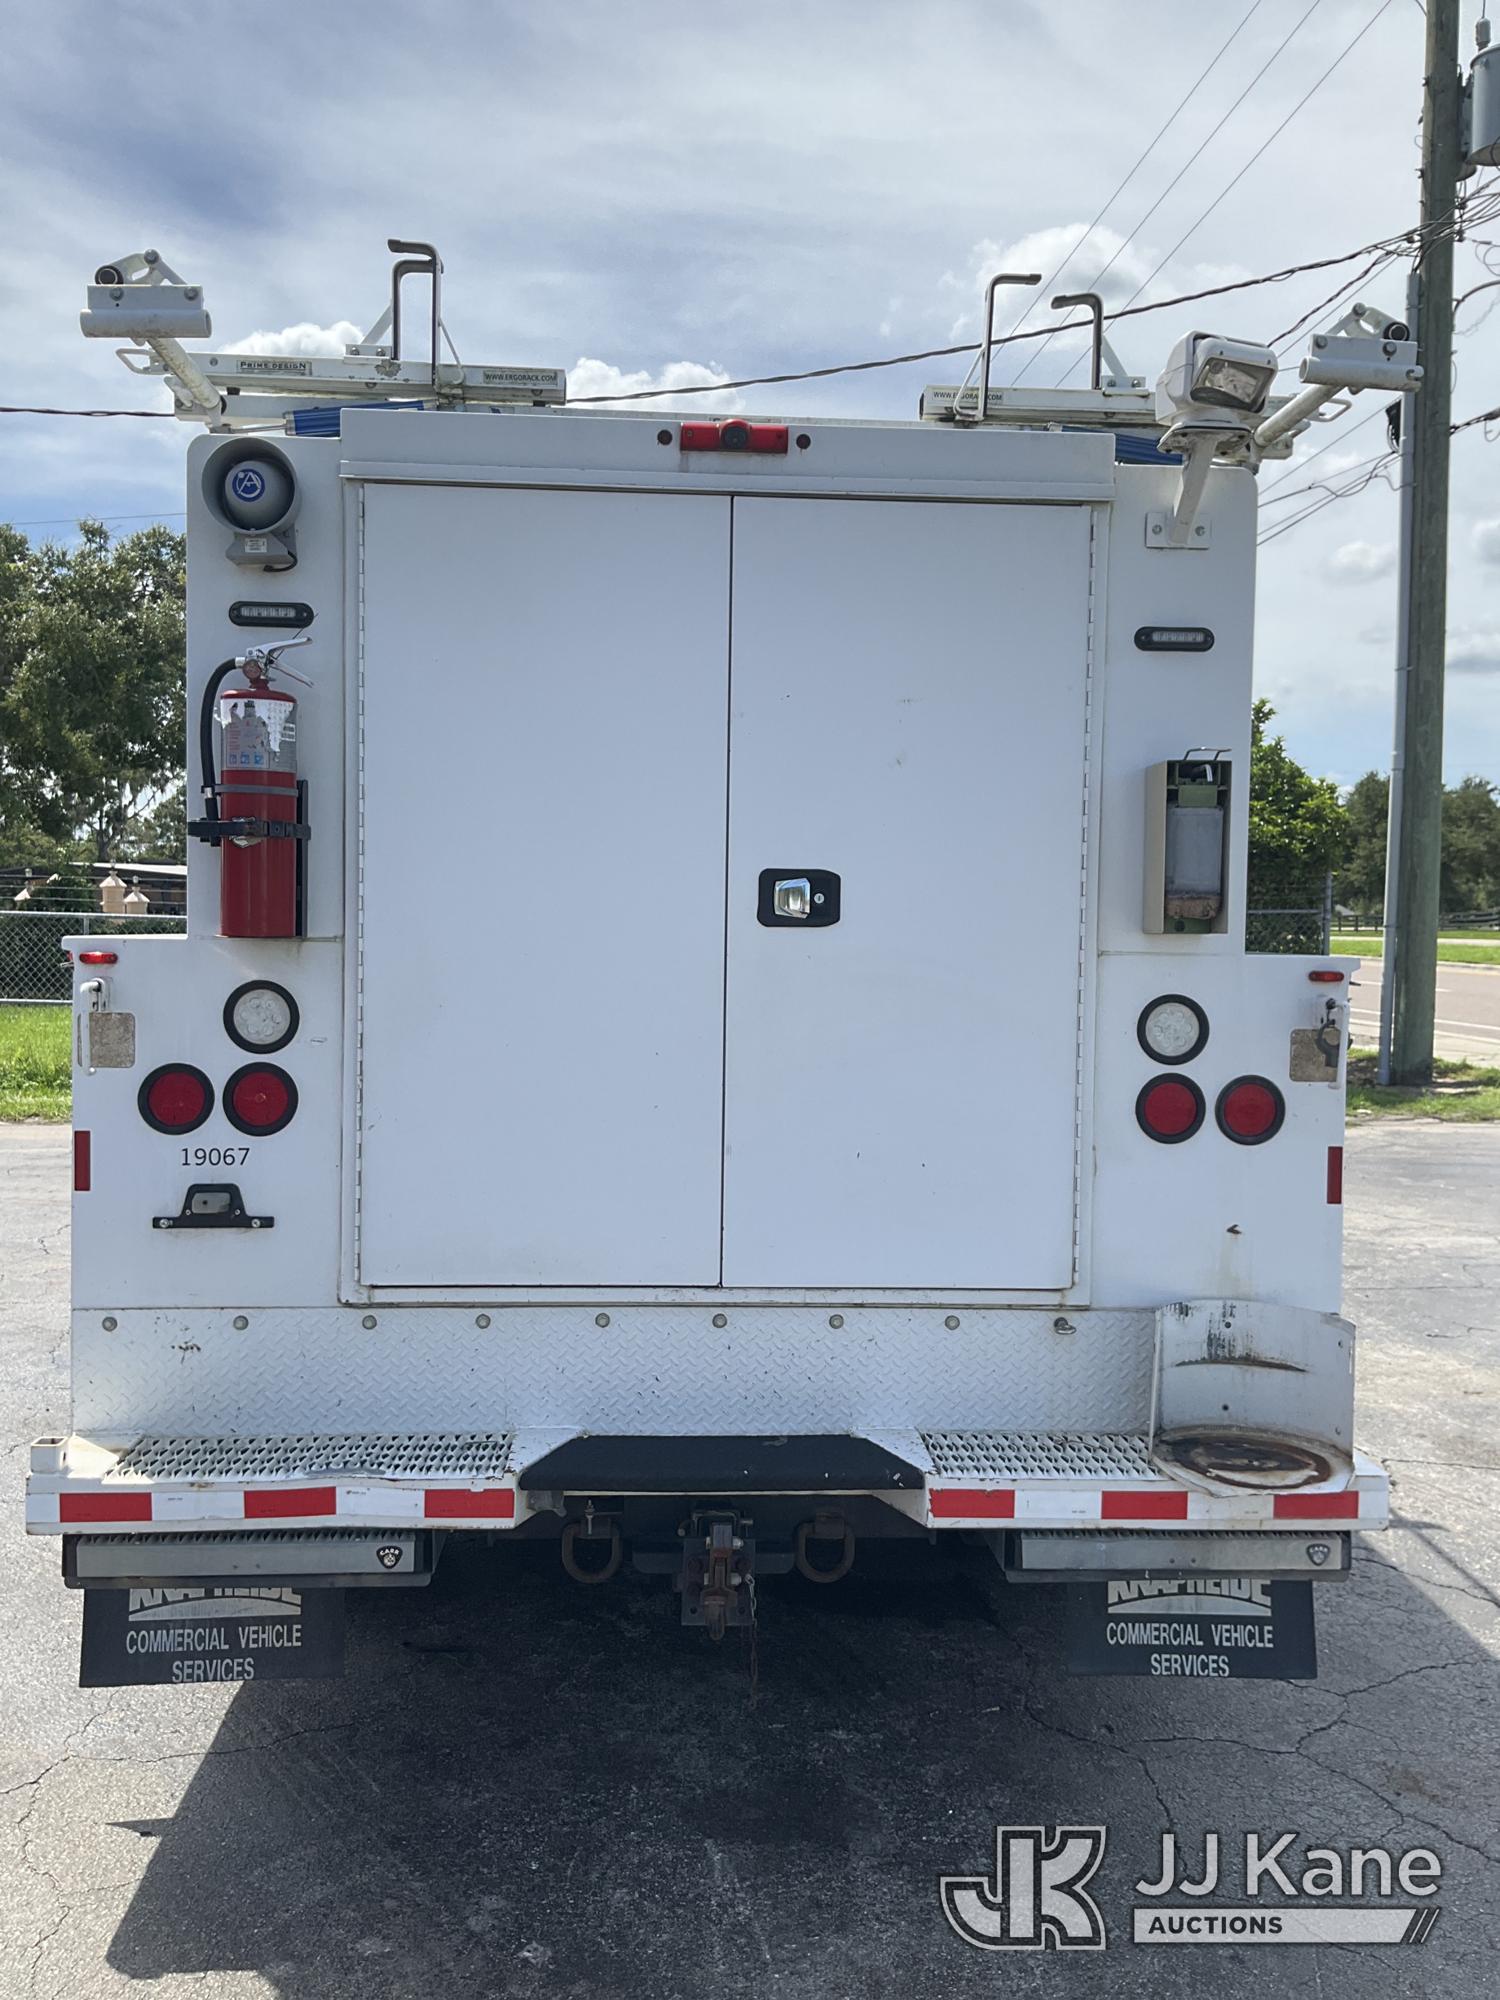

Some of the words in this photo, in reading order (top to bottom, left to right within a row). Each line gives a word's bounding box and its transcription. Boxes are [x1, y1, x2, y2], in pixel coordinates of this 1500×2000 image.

[240, 361, 268, 369] PRIME
[271, 362, 306, 370] DESIGN
[485, 372, 557, 383] WWW.ERGORACK.COM
[181, 1147, 250, 1166] 19067
[126, 1627, 229, 1654] COMMERCIAL
[238, 1624, 302, 1648] VEHICLE
[1106, 1622, 1204, 1646] COMMERCIAL
[1211, 1624, 1274, 1648] VEHICLE
[172, 1657, 255, 1683] SERVICES
[1151, 1653, 1230, 1677] SERVICES
